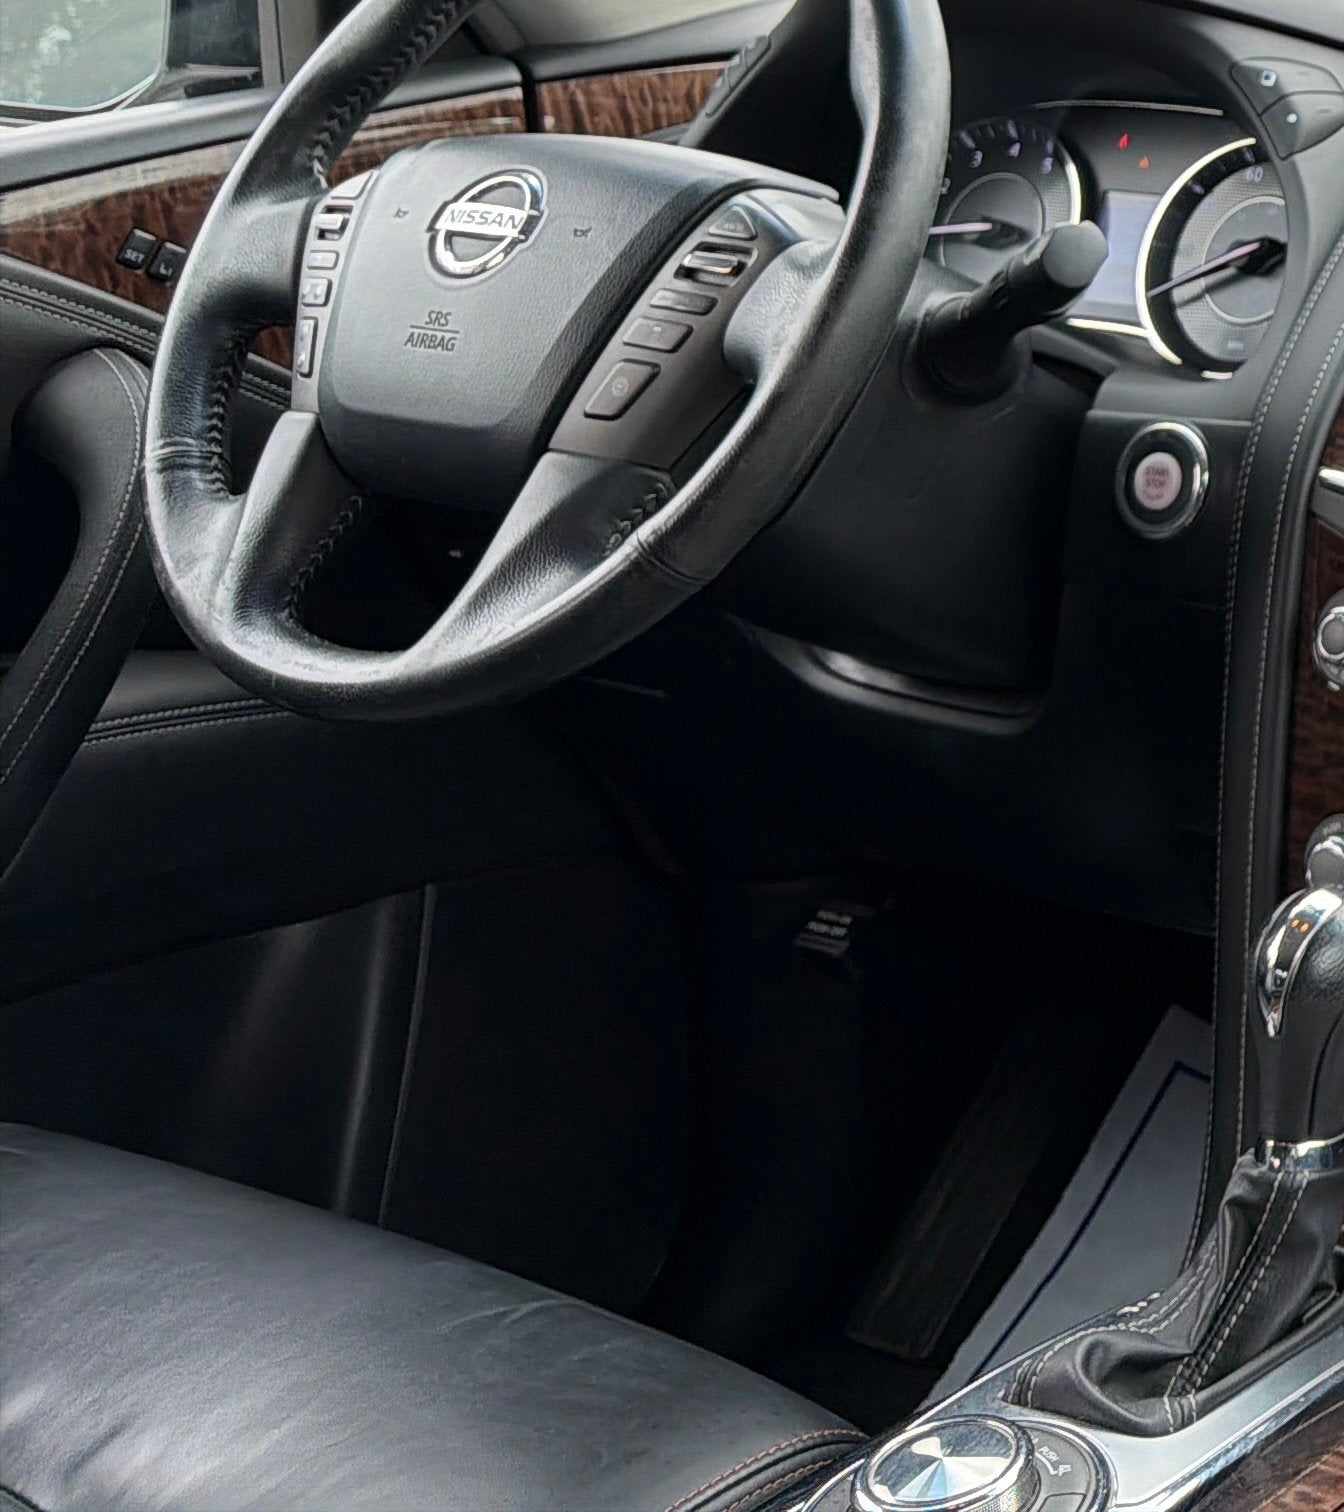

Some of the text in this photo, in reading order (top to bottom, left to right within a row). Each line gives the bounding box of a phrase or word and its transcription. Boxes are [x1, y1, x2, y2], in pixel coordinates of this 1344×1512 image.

[445, 208, 524, 230] NISSAN
[424, 309, 452, 327] SRS
[404, 331, 457, 352] AIRBAG
